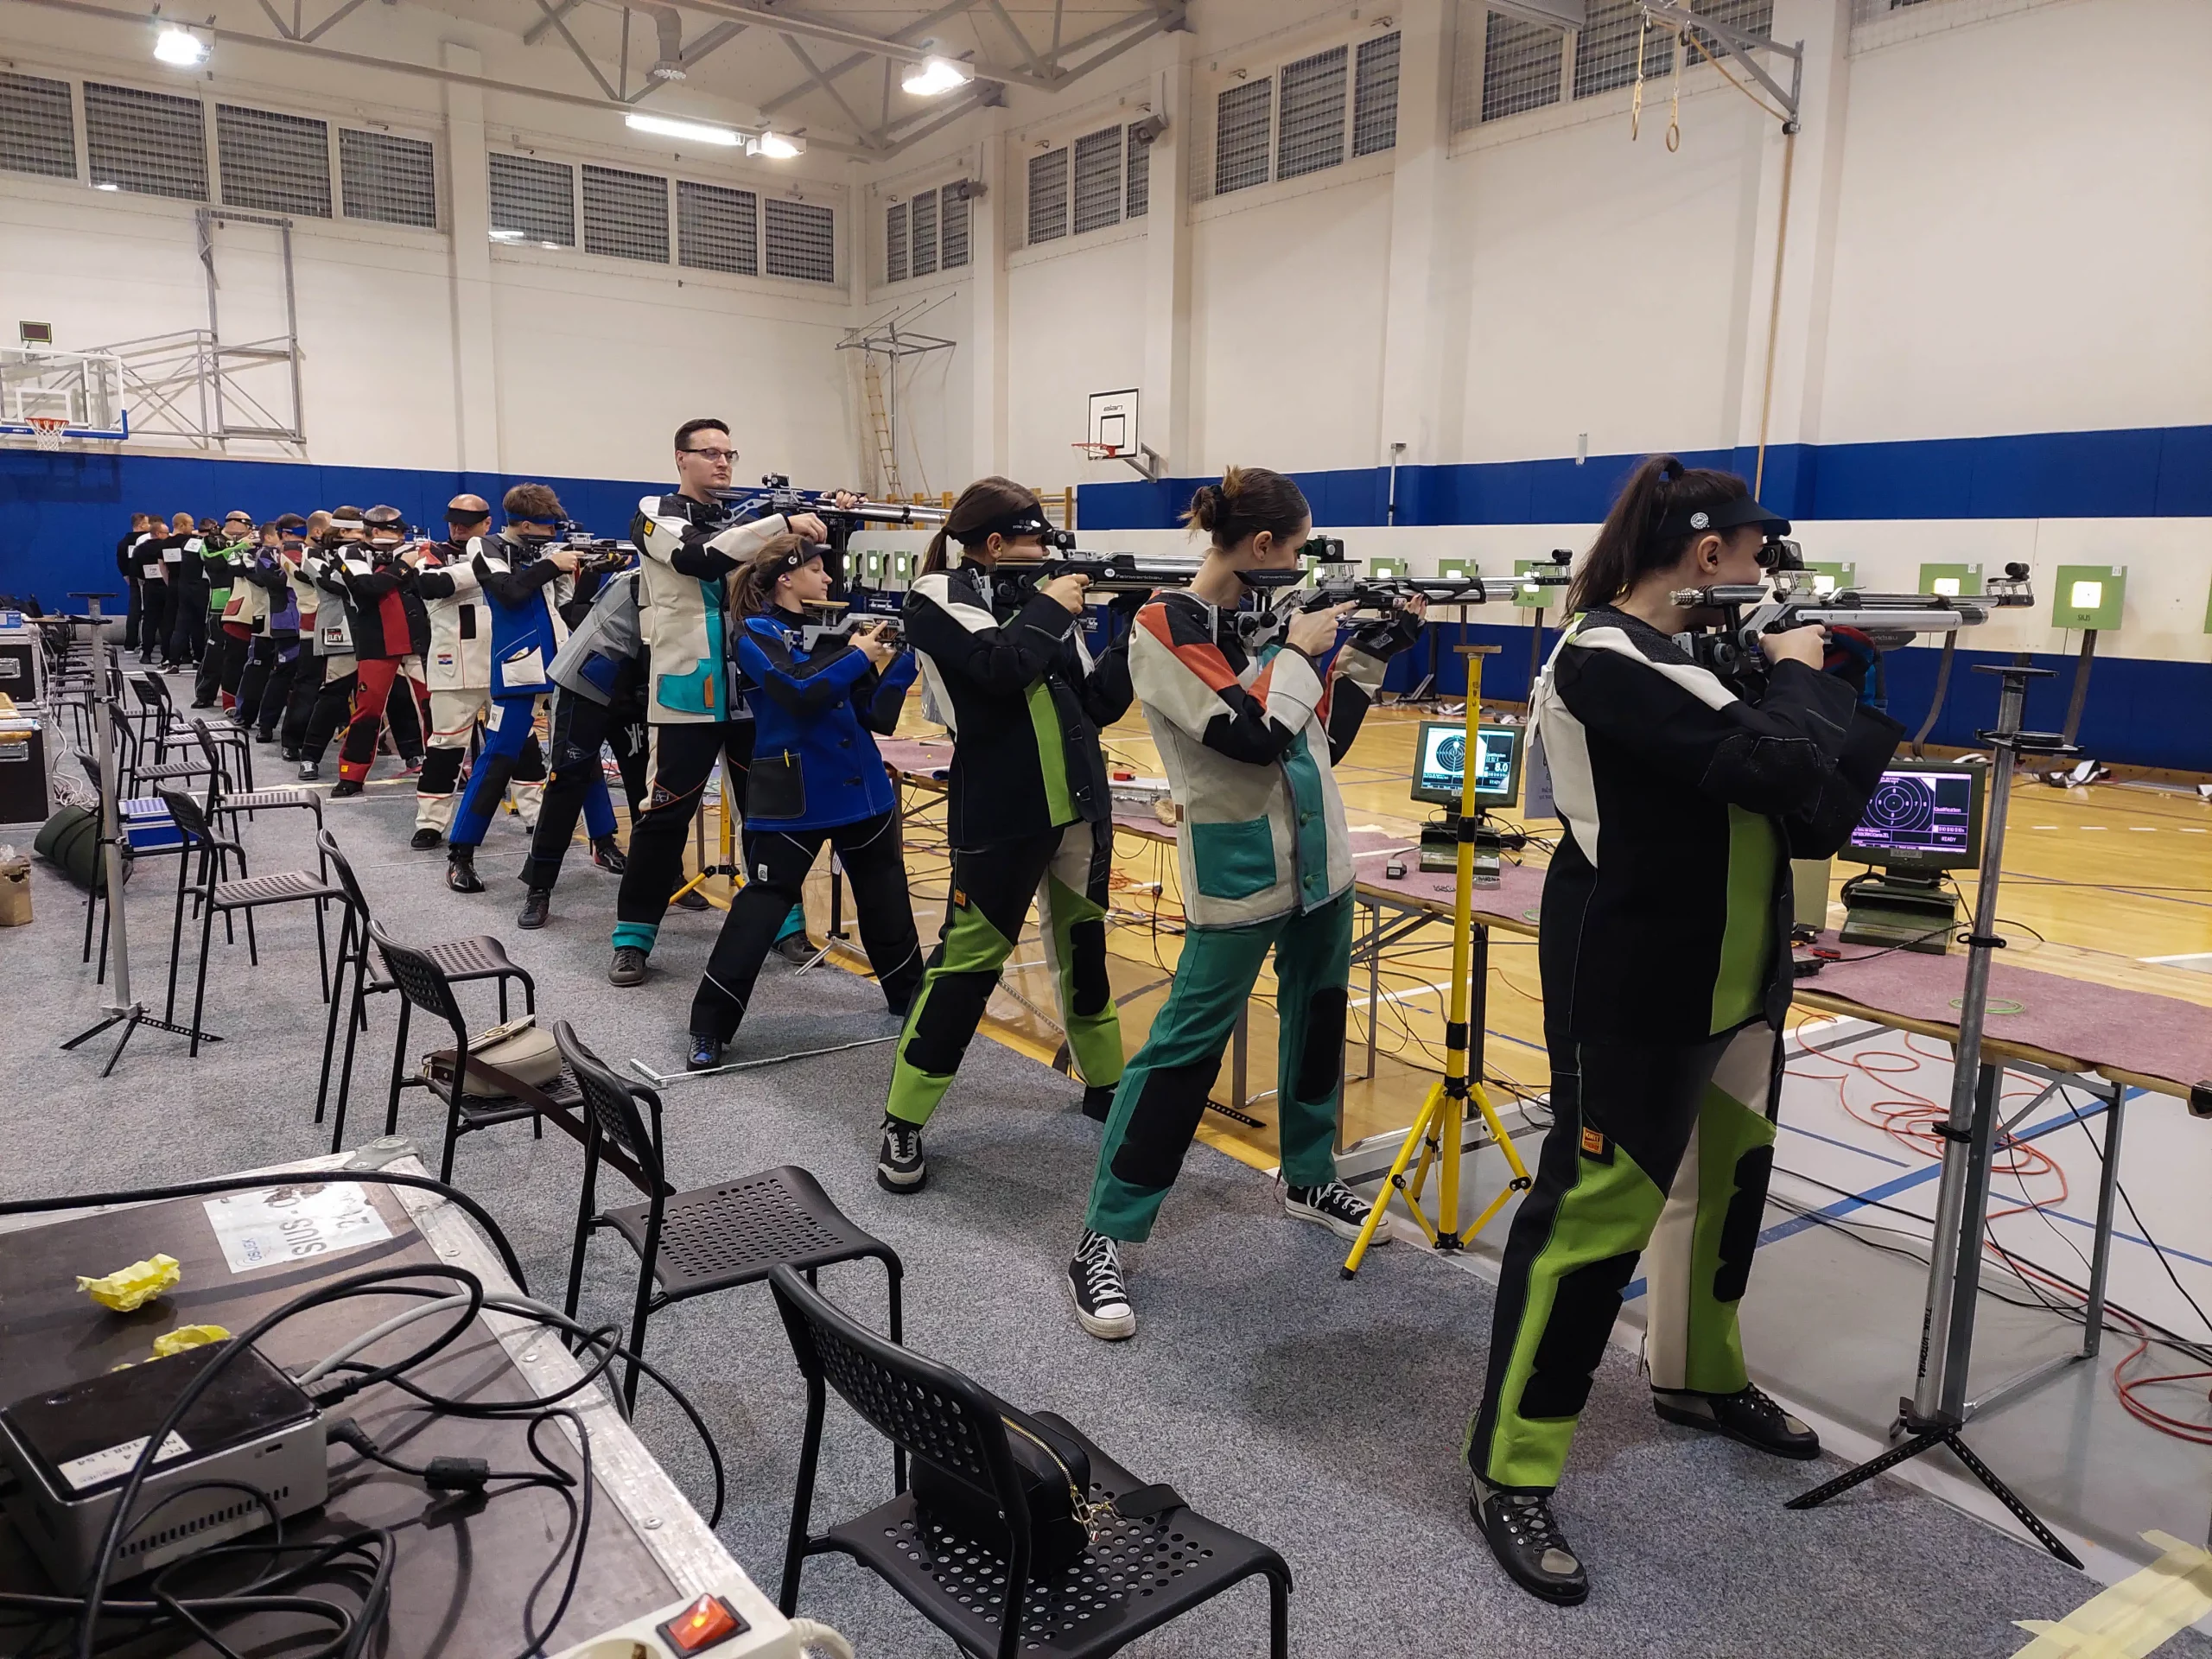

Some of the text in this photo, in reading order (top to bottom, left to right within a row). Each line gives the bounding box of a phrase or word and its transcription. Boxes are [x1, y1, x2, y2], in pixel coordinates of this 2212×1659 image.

[2076, 613, 2091, 622] SIUS
[1494, 762, 1509, 772] 8.0
[278, 1217, 327, 1255] SIUS
